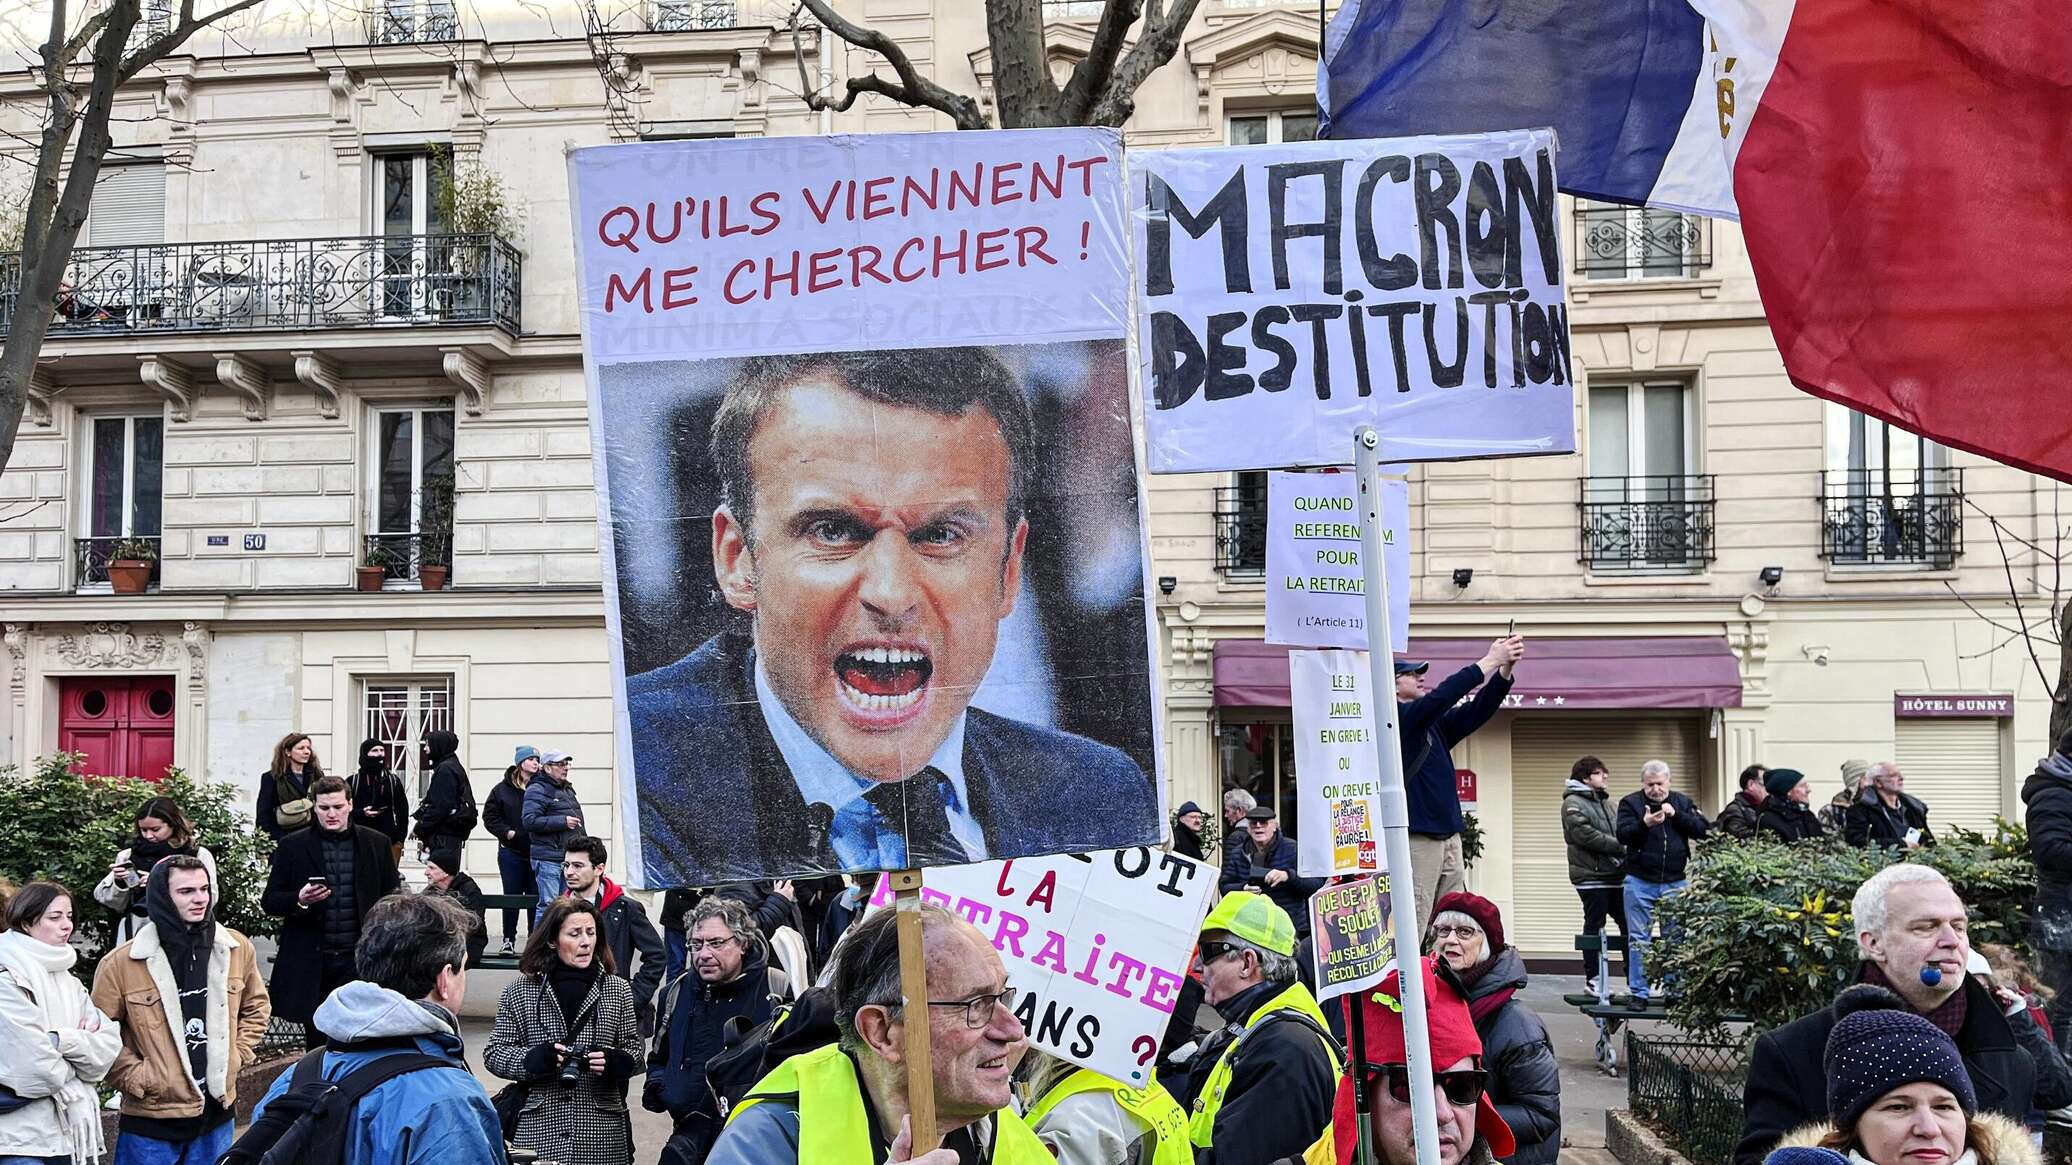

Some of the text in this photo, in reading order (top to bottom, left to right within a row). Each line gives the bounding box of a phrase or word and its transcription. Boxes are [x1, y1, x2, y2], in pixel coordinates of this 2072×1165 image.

[802, 154, 1108, 225] VIENNENT
[1146, 148, 1559, 297] MACRON
[604, 265, 699, 313] ME
[723, 226, 1059, 305] CHERCHER
[1080, 220, 1091, 261] !
[1294, 497, 1354, 512] QUAND
[1294, 523, 1394, 543] REFERENM
[245, 535, 263, 549] 50
[1316, 550, 1359, 566] POUR
[1286, 576, 1305, 590] LA
[1349, 618, 1364, 629] 11)
[1332, 675, 1354, 689] LE 31
[1329, 703, 1361, 716] JANVIER
[1902, 697, 2008, 711] HÔTEL SUNNY
[1321, 730, 1336, 743] EN
[1338, 729, 1362, 743] GREVE
[1339, 757, 1350, 770] OU
[1322, 784, 1340, 799] ON
[1342, 782, 1372, 798] CREVE
[1359, 849, 1377, 863] cgt
[1317, 891, 1339, 915] QUE
[1340, 886, 1360, 908] CE
[1327, 949, 1343, 965] QUI
[1343, 943, 1371, 960] SÈME
[1327, 961, 1369, 983] RÉCOLTE
[1131, 1034, 1158, 1081] ?
